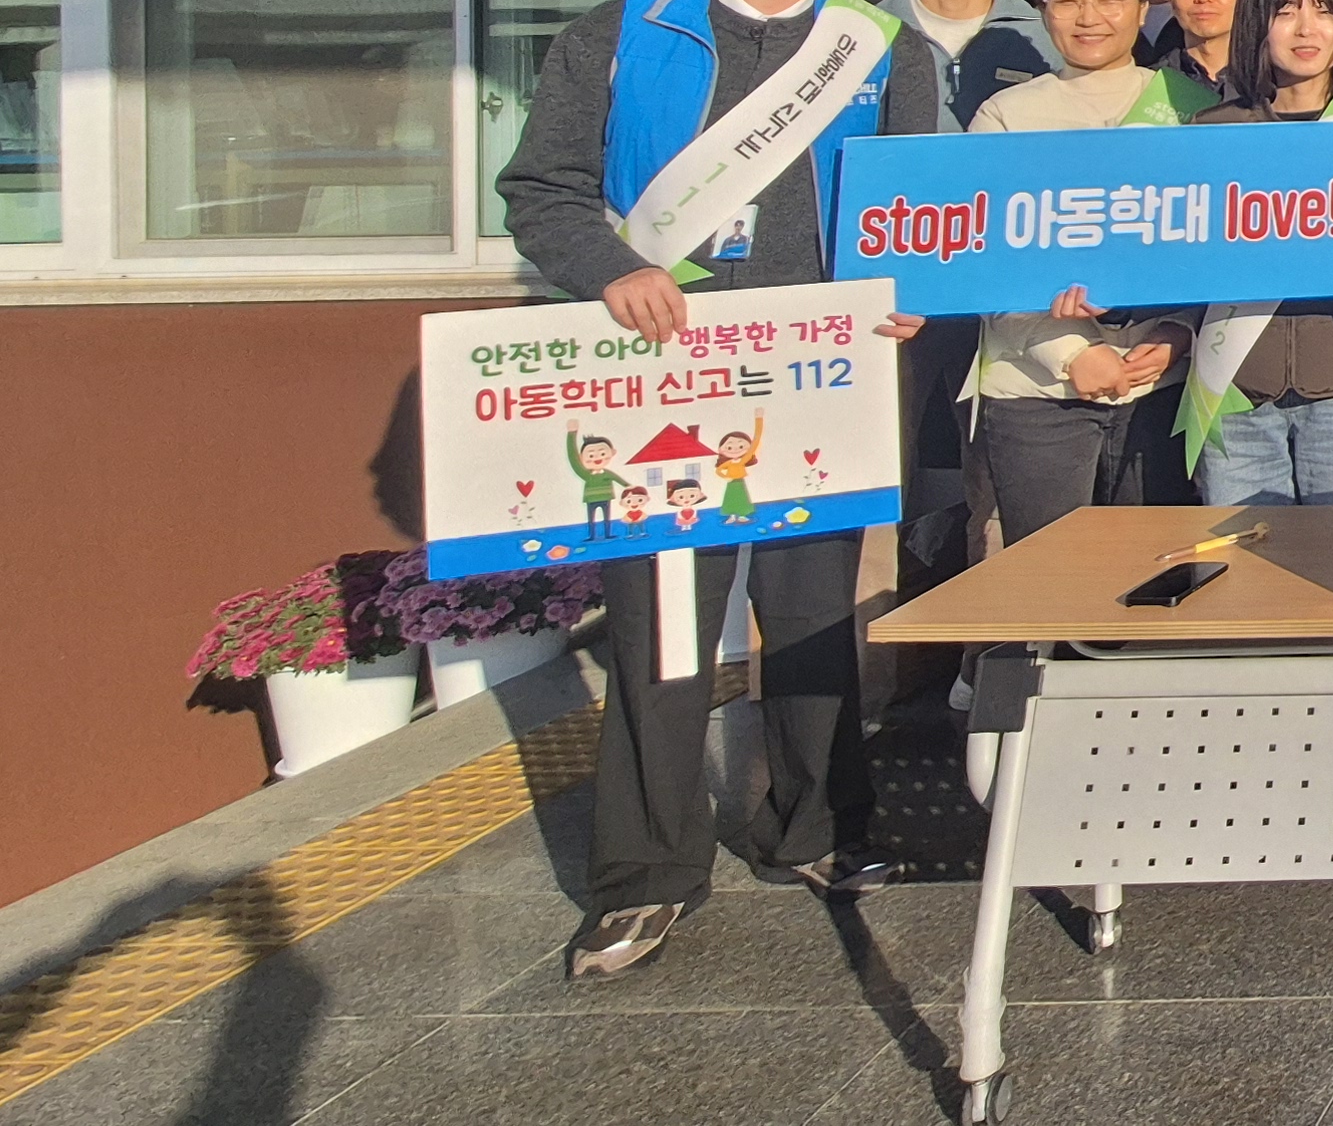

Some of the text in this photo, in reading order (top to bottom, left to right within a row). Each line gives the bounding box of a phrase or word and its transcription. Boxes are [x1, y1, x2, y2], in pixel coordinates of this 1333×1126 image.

[795, 33, 858, 105] 아동학대
[734, 102, 802, 160] 신고는
[858, 191, 987, 263] stop!
[1005, 183, 1211, 250] 아동학대
[471, 314, 853, 376] 안전한 아이 행복한 가정
[475, 358, 854, 422] 아동학대 신고는 112
